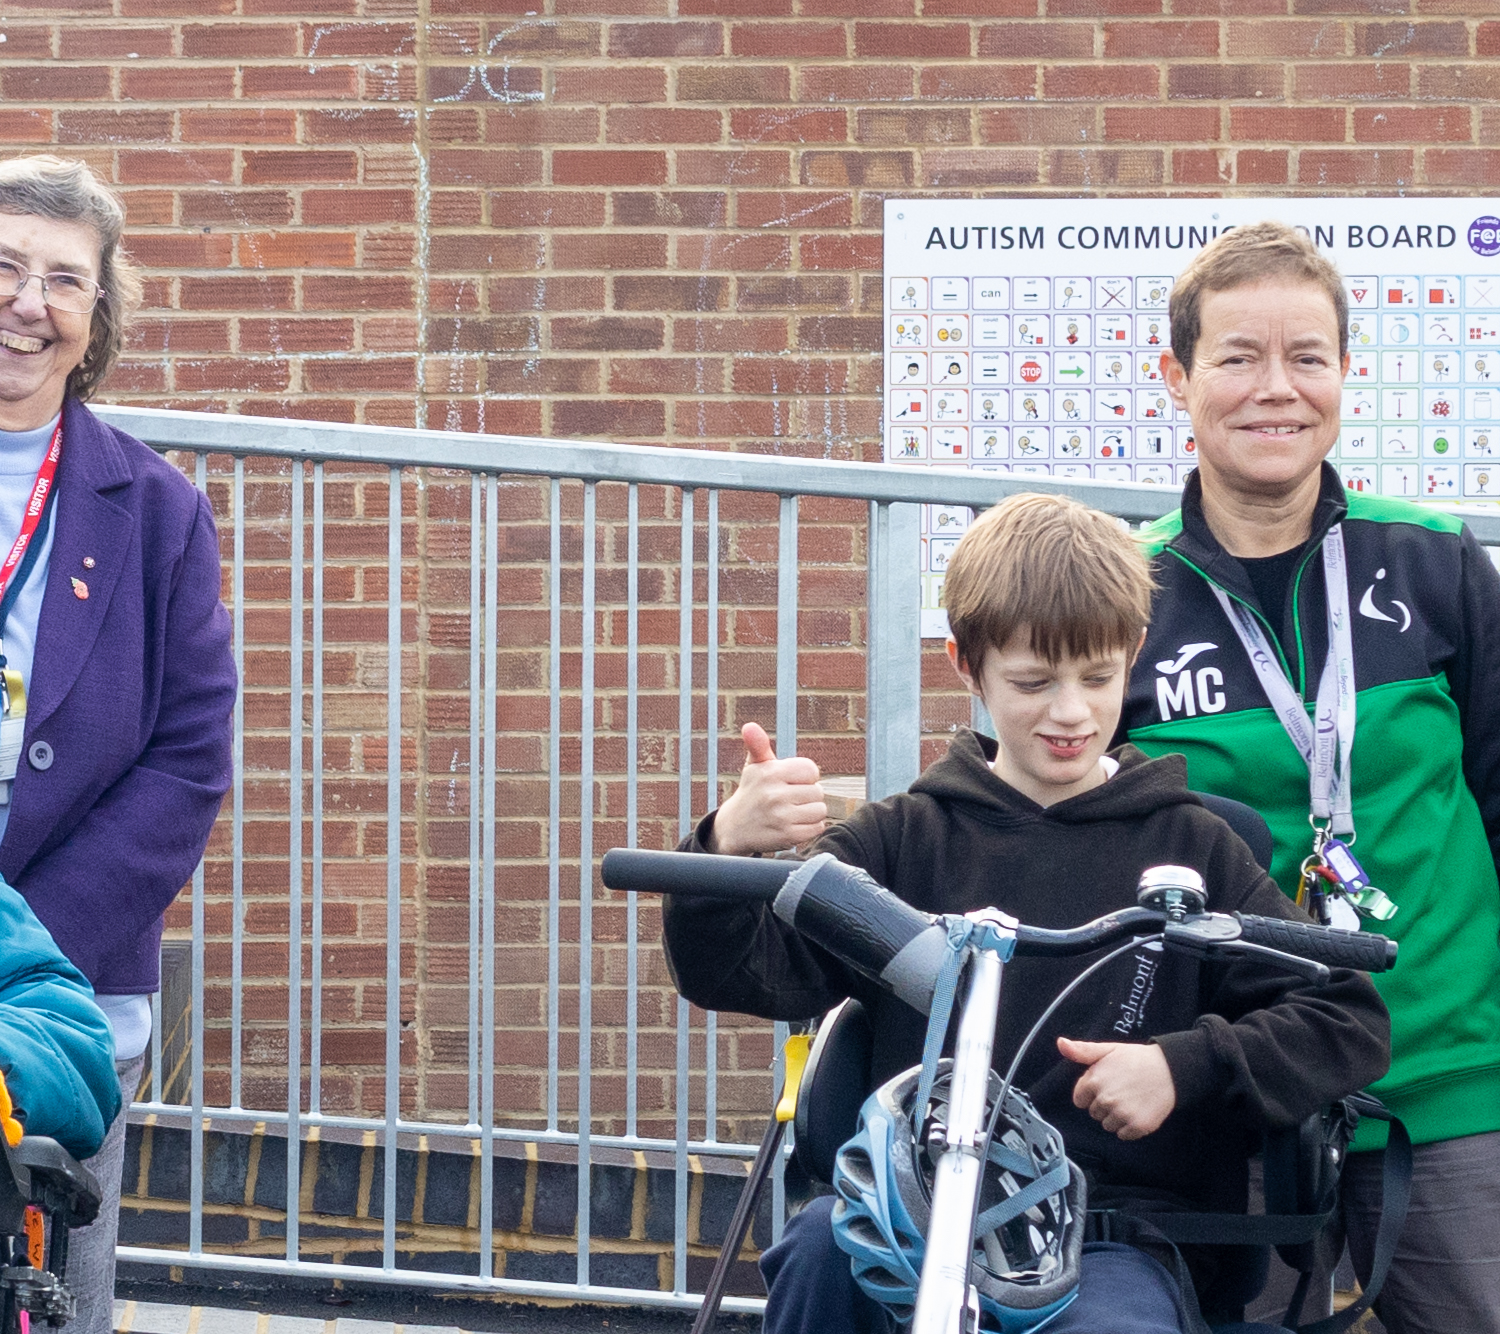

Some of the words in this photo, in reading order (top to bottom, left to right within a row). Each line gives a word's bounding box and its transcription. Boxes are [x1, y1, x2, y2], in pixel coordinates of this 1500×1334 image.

[925, 226, 1045, 249] AUTISM
[1058, 225, 1334, 249] COMMUNIN
[1348, 225, 1457, 249] BOARD
[981, 290, 1001, 298] can
[1021, 368, 1041, 377] STOP
[1352, 436, 1365, 448] of
[27, 478, 49, 517] VISITOR
[5, 532, 28, 568] VISITOR
[1156, 667, 1227, 722] MC
[1318, 737, 1329, 778] Belmont
[1113, 954, 1154, 1035] Belmont
